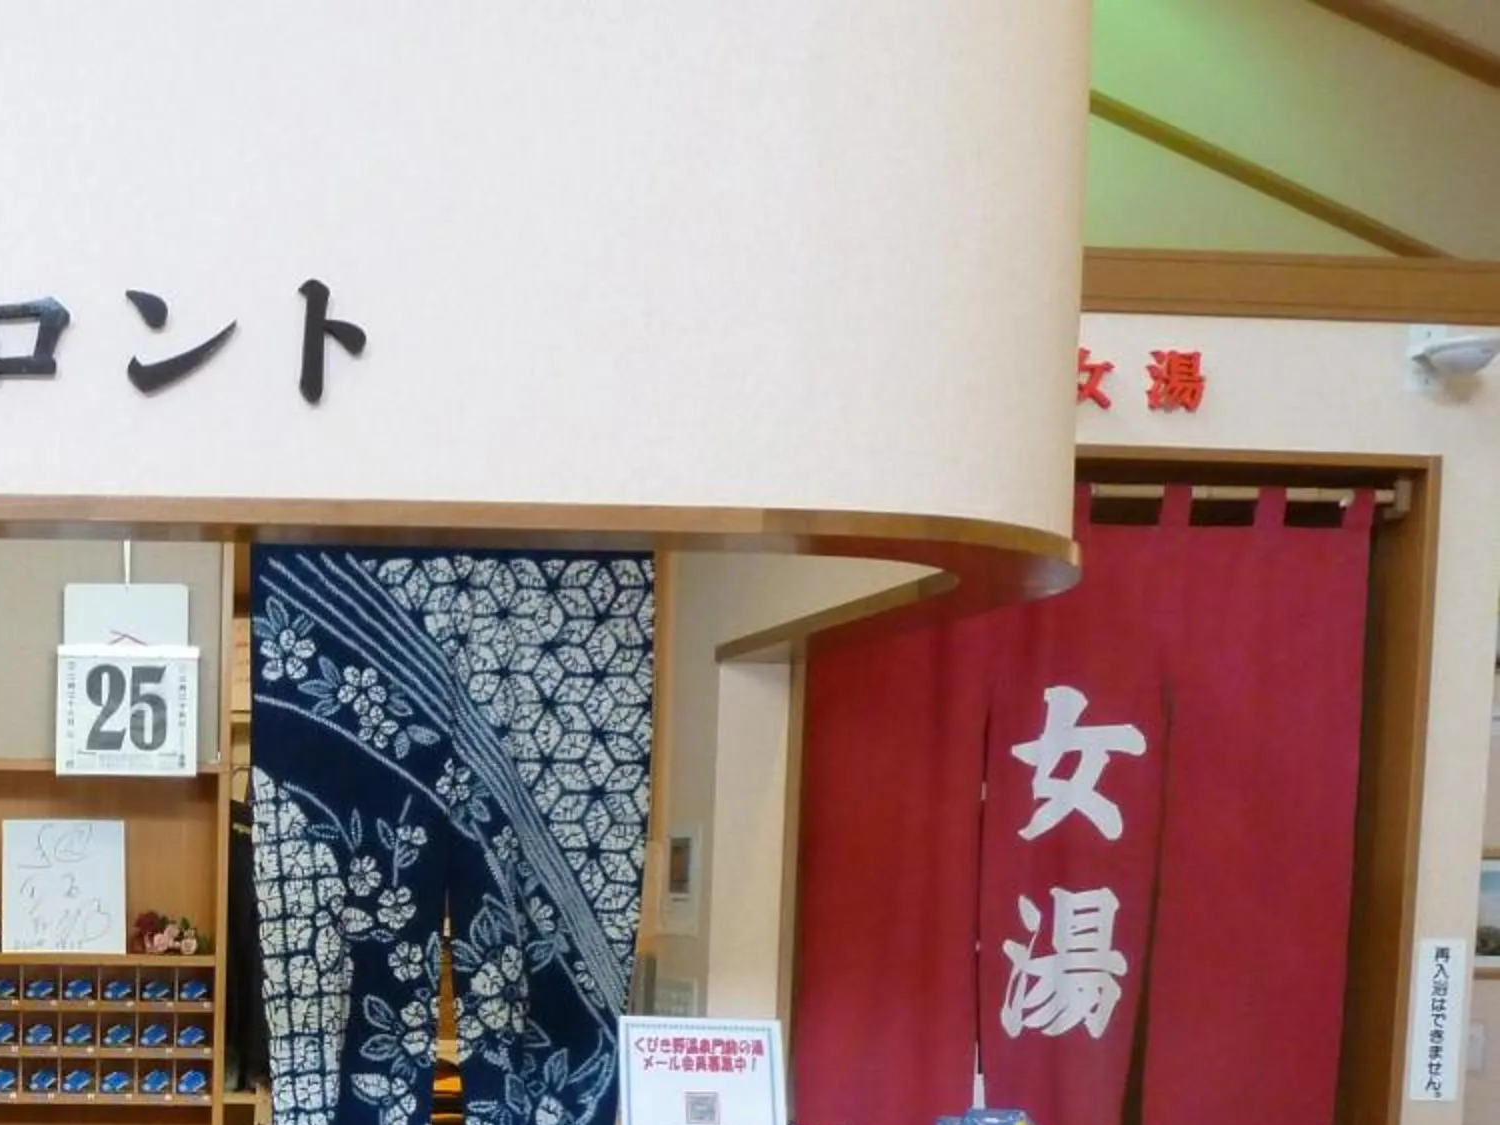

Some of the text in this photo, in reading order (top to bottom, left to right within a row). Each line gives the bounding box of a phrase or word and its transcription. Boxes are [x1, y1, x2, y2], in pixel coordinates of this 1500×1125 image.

[86, 664, 167, 751] 25
[1001, 686, 1148, 1039] 女湯
[1425, 947, 1451, 1098] 再入浴はできません。
